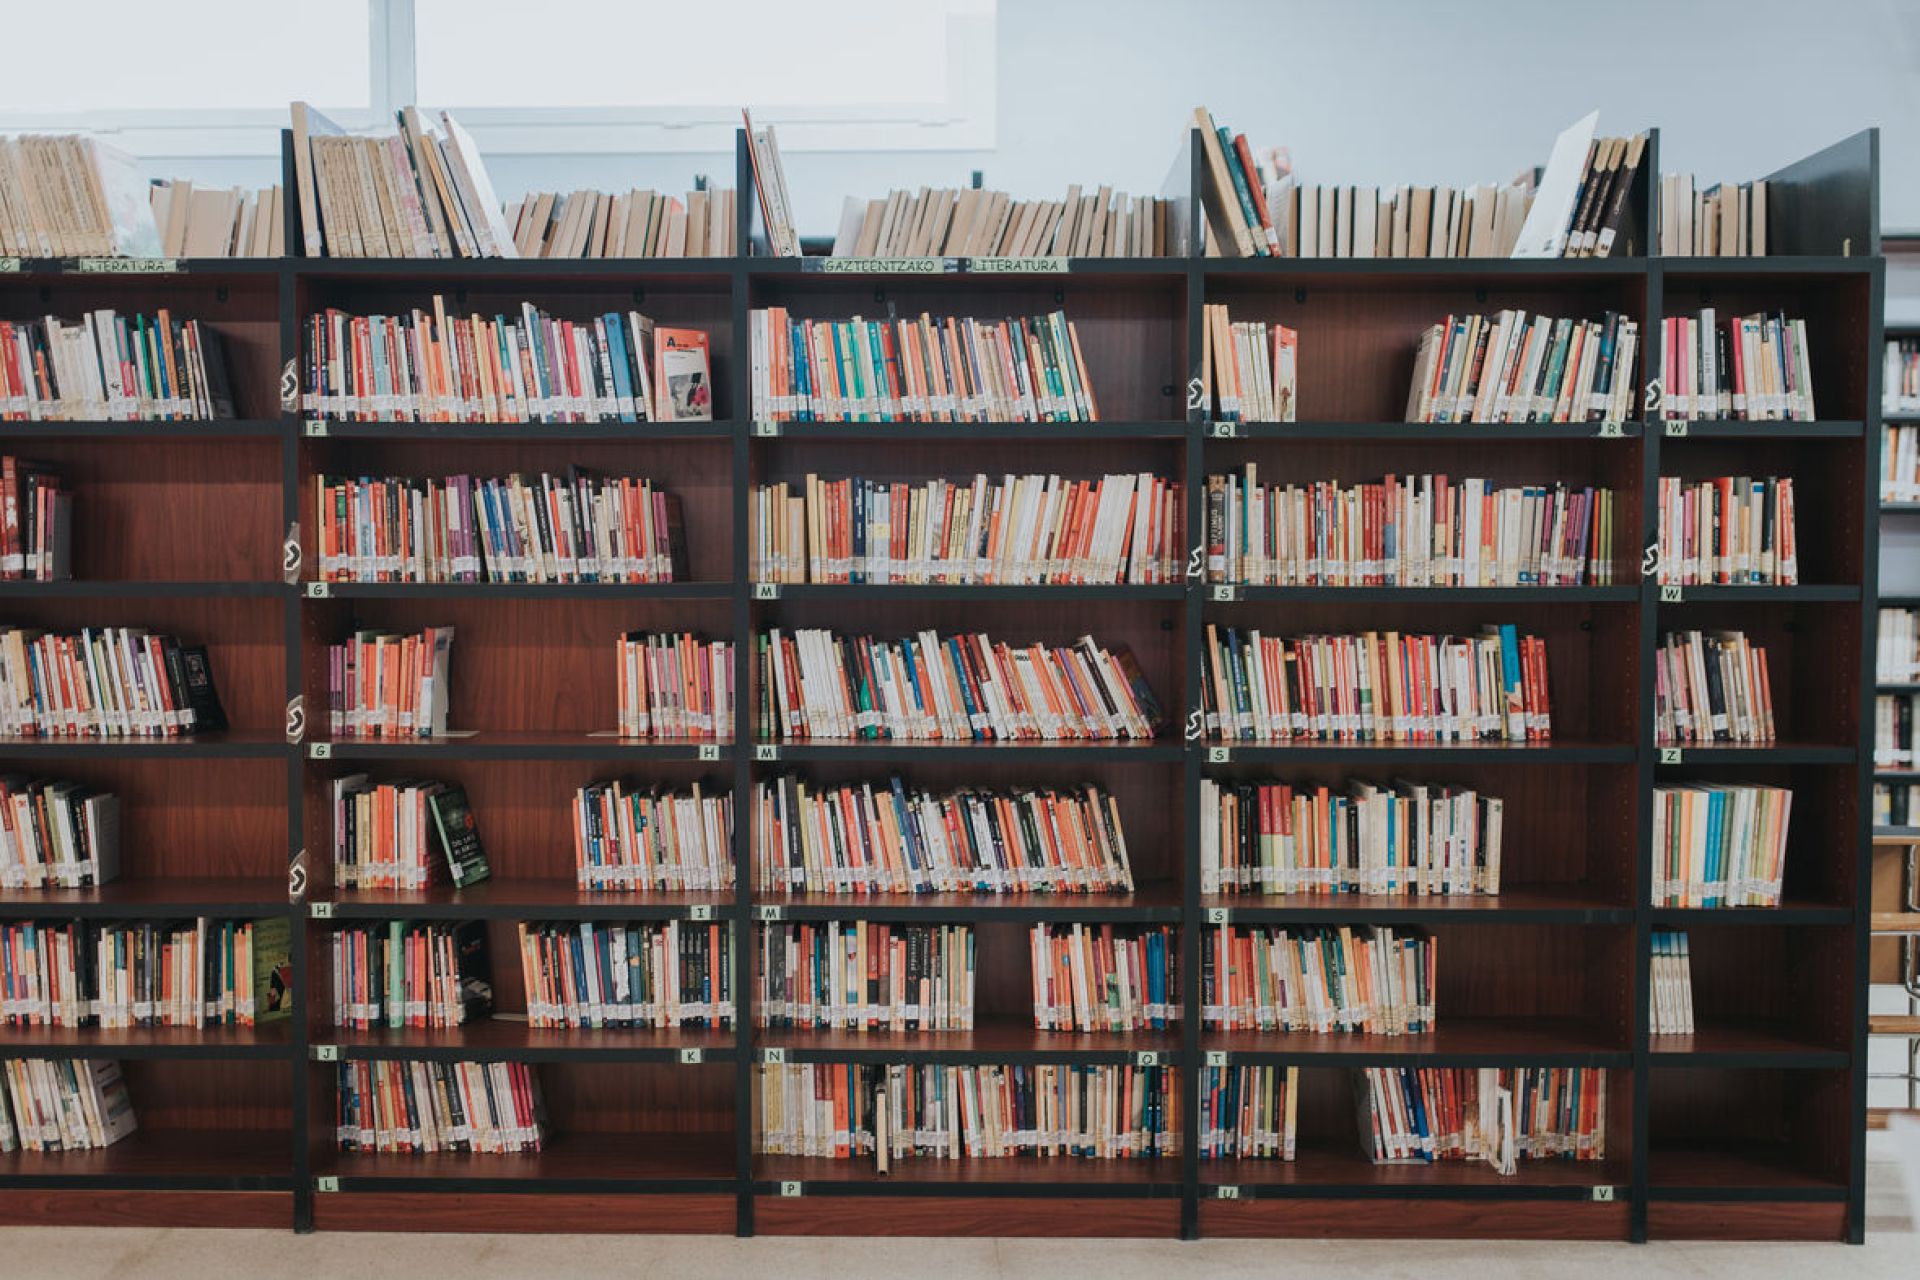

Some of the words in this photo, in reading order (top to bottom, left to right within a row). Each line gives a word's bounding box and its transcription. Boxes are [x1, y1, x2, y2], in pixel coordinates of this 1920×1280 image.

[81, 260, 165, 272] LITERATURA
[826, 260, 935, 272] GAZTEENTZAKO
[974, 259, 1059, 272] LITERATURA
